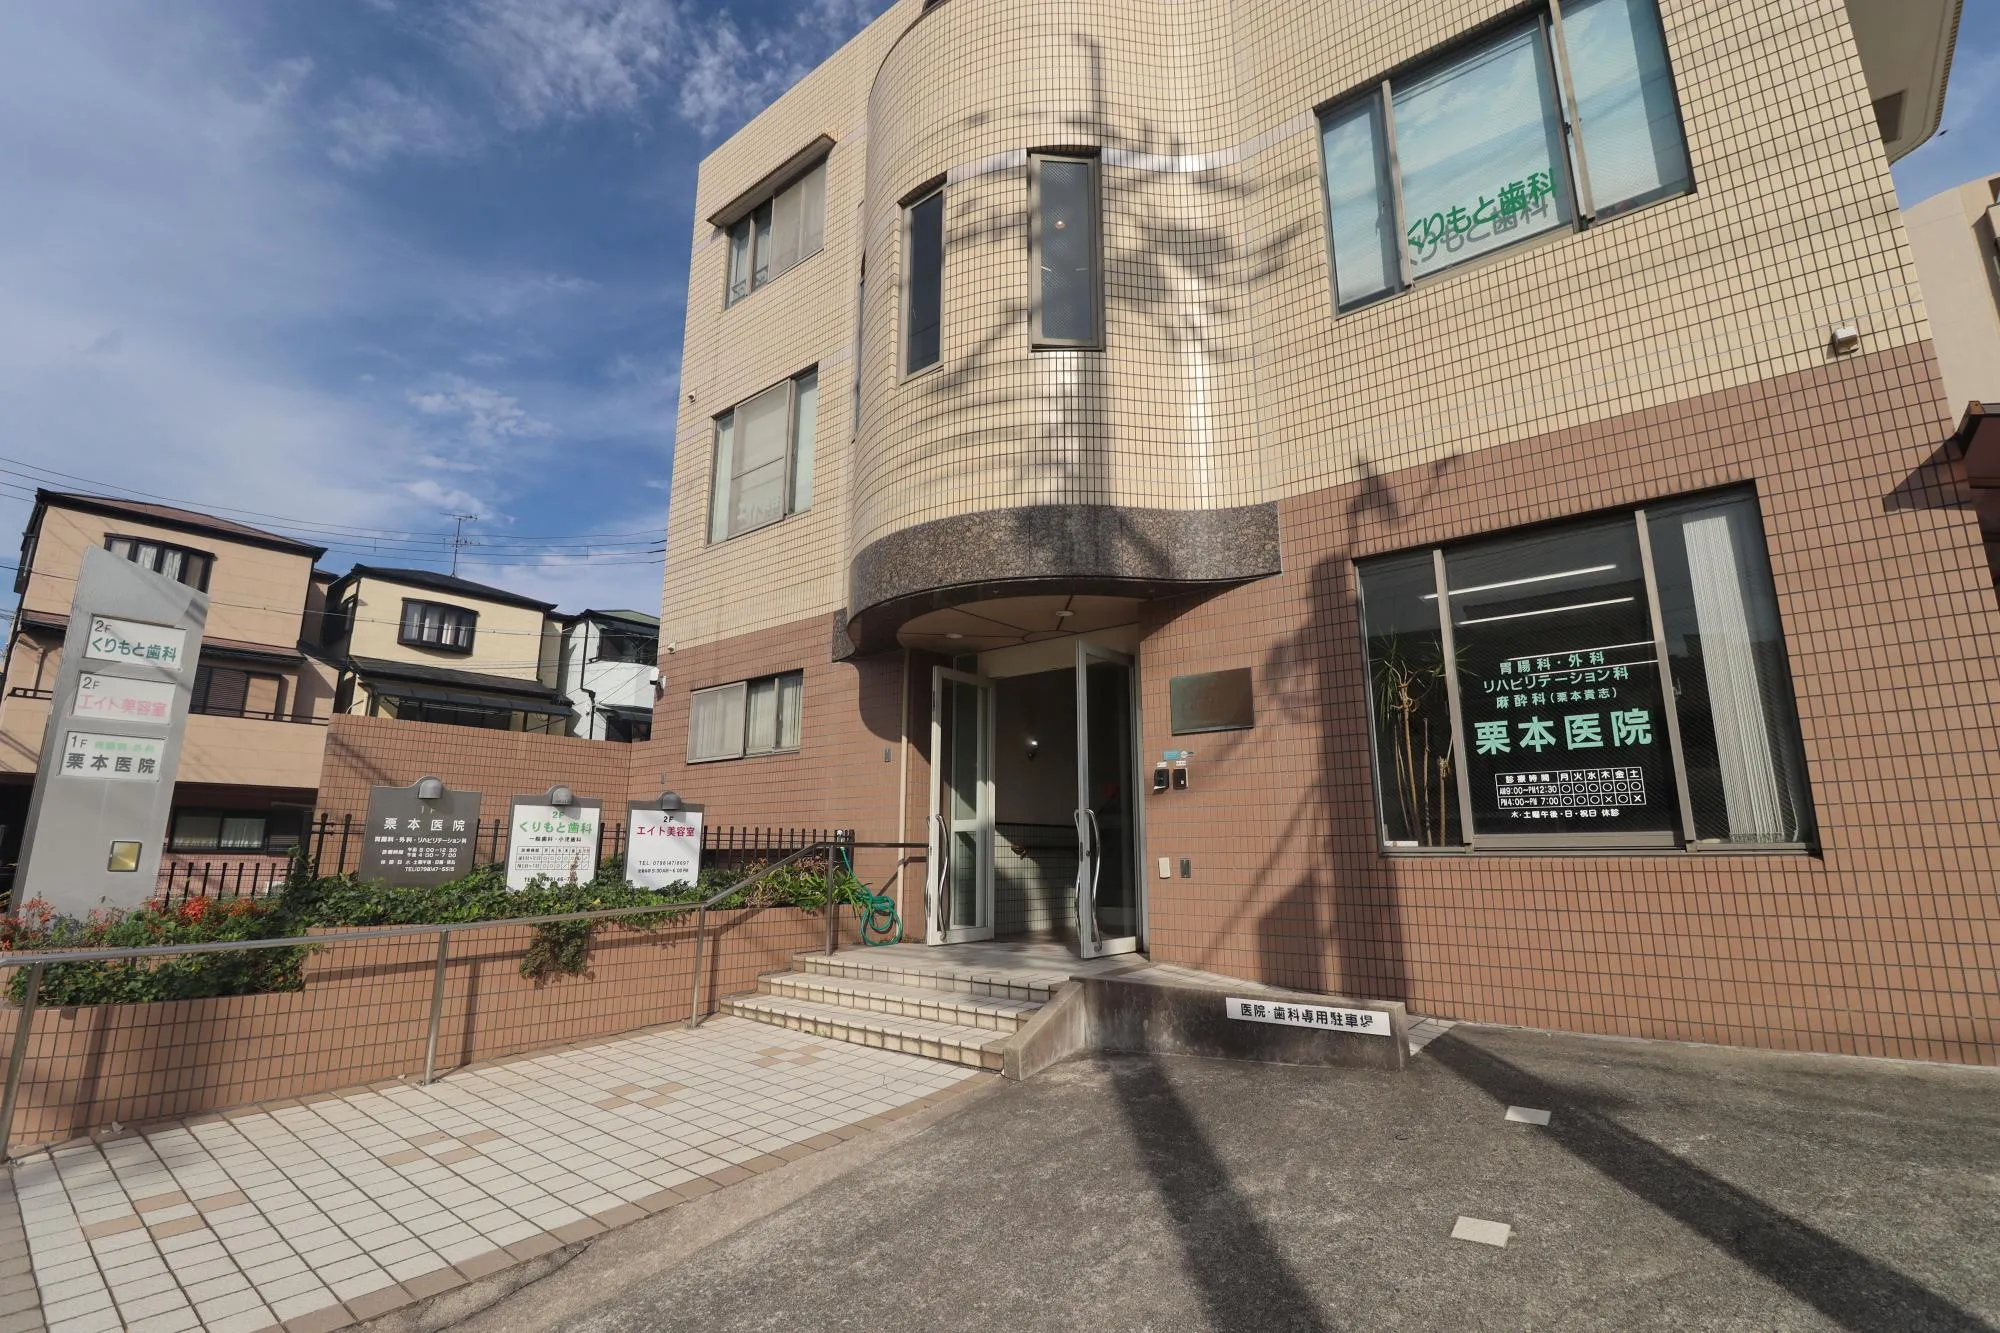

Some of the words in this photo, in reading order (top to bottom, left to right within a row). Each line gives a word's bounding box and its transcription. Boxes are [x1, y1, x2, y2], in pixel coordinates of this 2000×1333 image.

[1407, 168, 1557, 249] くりもと歯科
[94, 620, 112, 633] 2F
[92, 637, 177, 662] くりもと歯科
[1500, 651, 1605, 675] 胃腸科・外科
[82, 677, 100, 690] 2F
[1483, 665, 1629, 694] リハビリテーション科
[78, 694, 168, 718] エイト美容室
[1474, 707, 1652, 755] 栗本医院
[66, 752, 156, 774] 栗本医院
[1505, 773, 1550, 784] 診療時間
[1560, 772, 1569, 782] 月
[1573, 772, 1583, 781] 火
[1587, 771, 1597, 780] 水
[1600, 770, 1611, 779] 木
[1615, 770, 1625, 779] 金
[1629, 769, 1640, 778] 土
[552, 810, 565, 819] 2F
[663, 815, 674, 823] 2F
[1601, 808, 1620, 817] 休診
[383, 817, 466, 832] 栗本医院
[519, 821, 592, 834] くりもと歯科
[637, 826, 695, 837] エイト美容室
